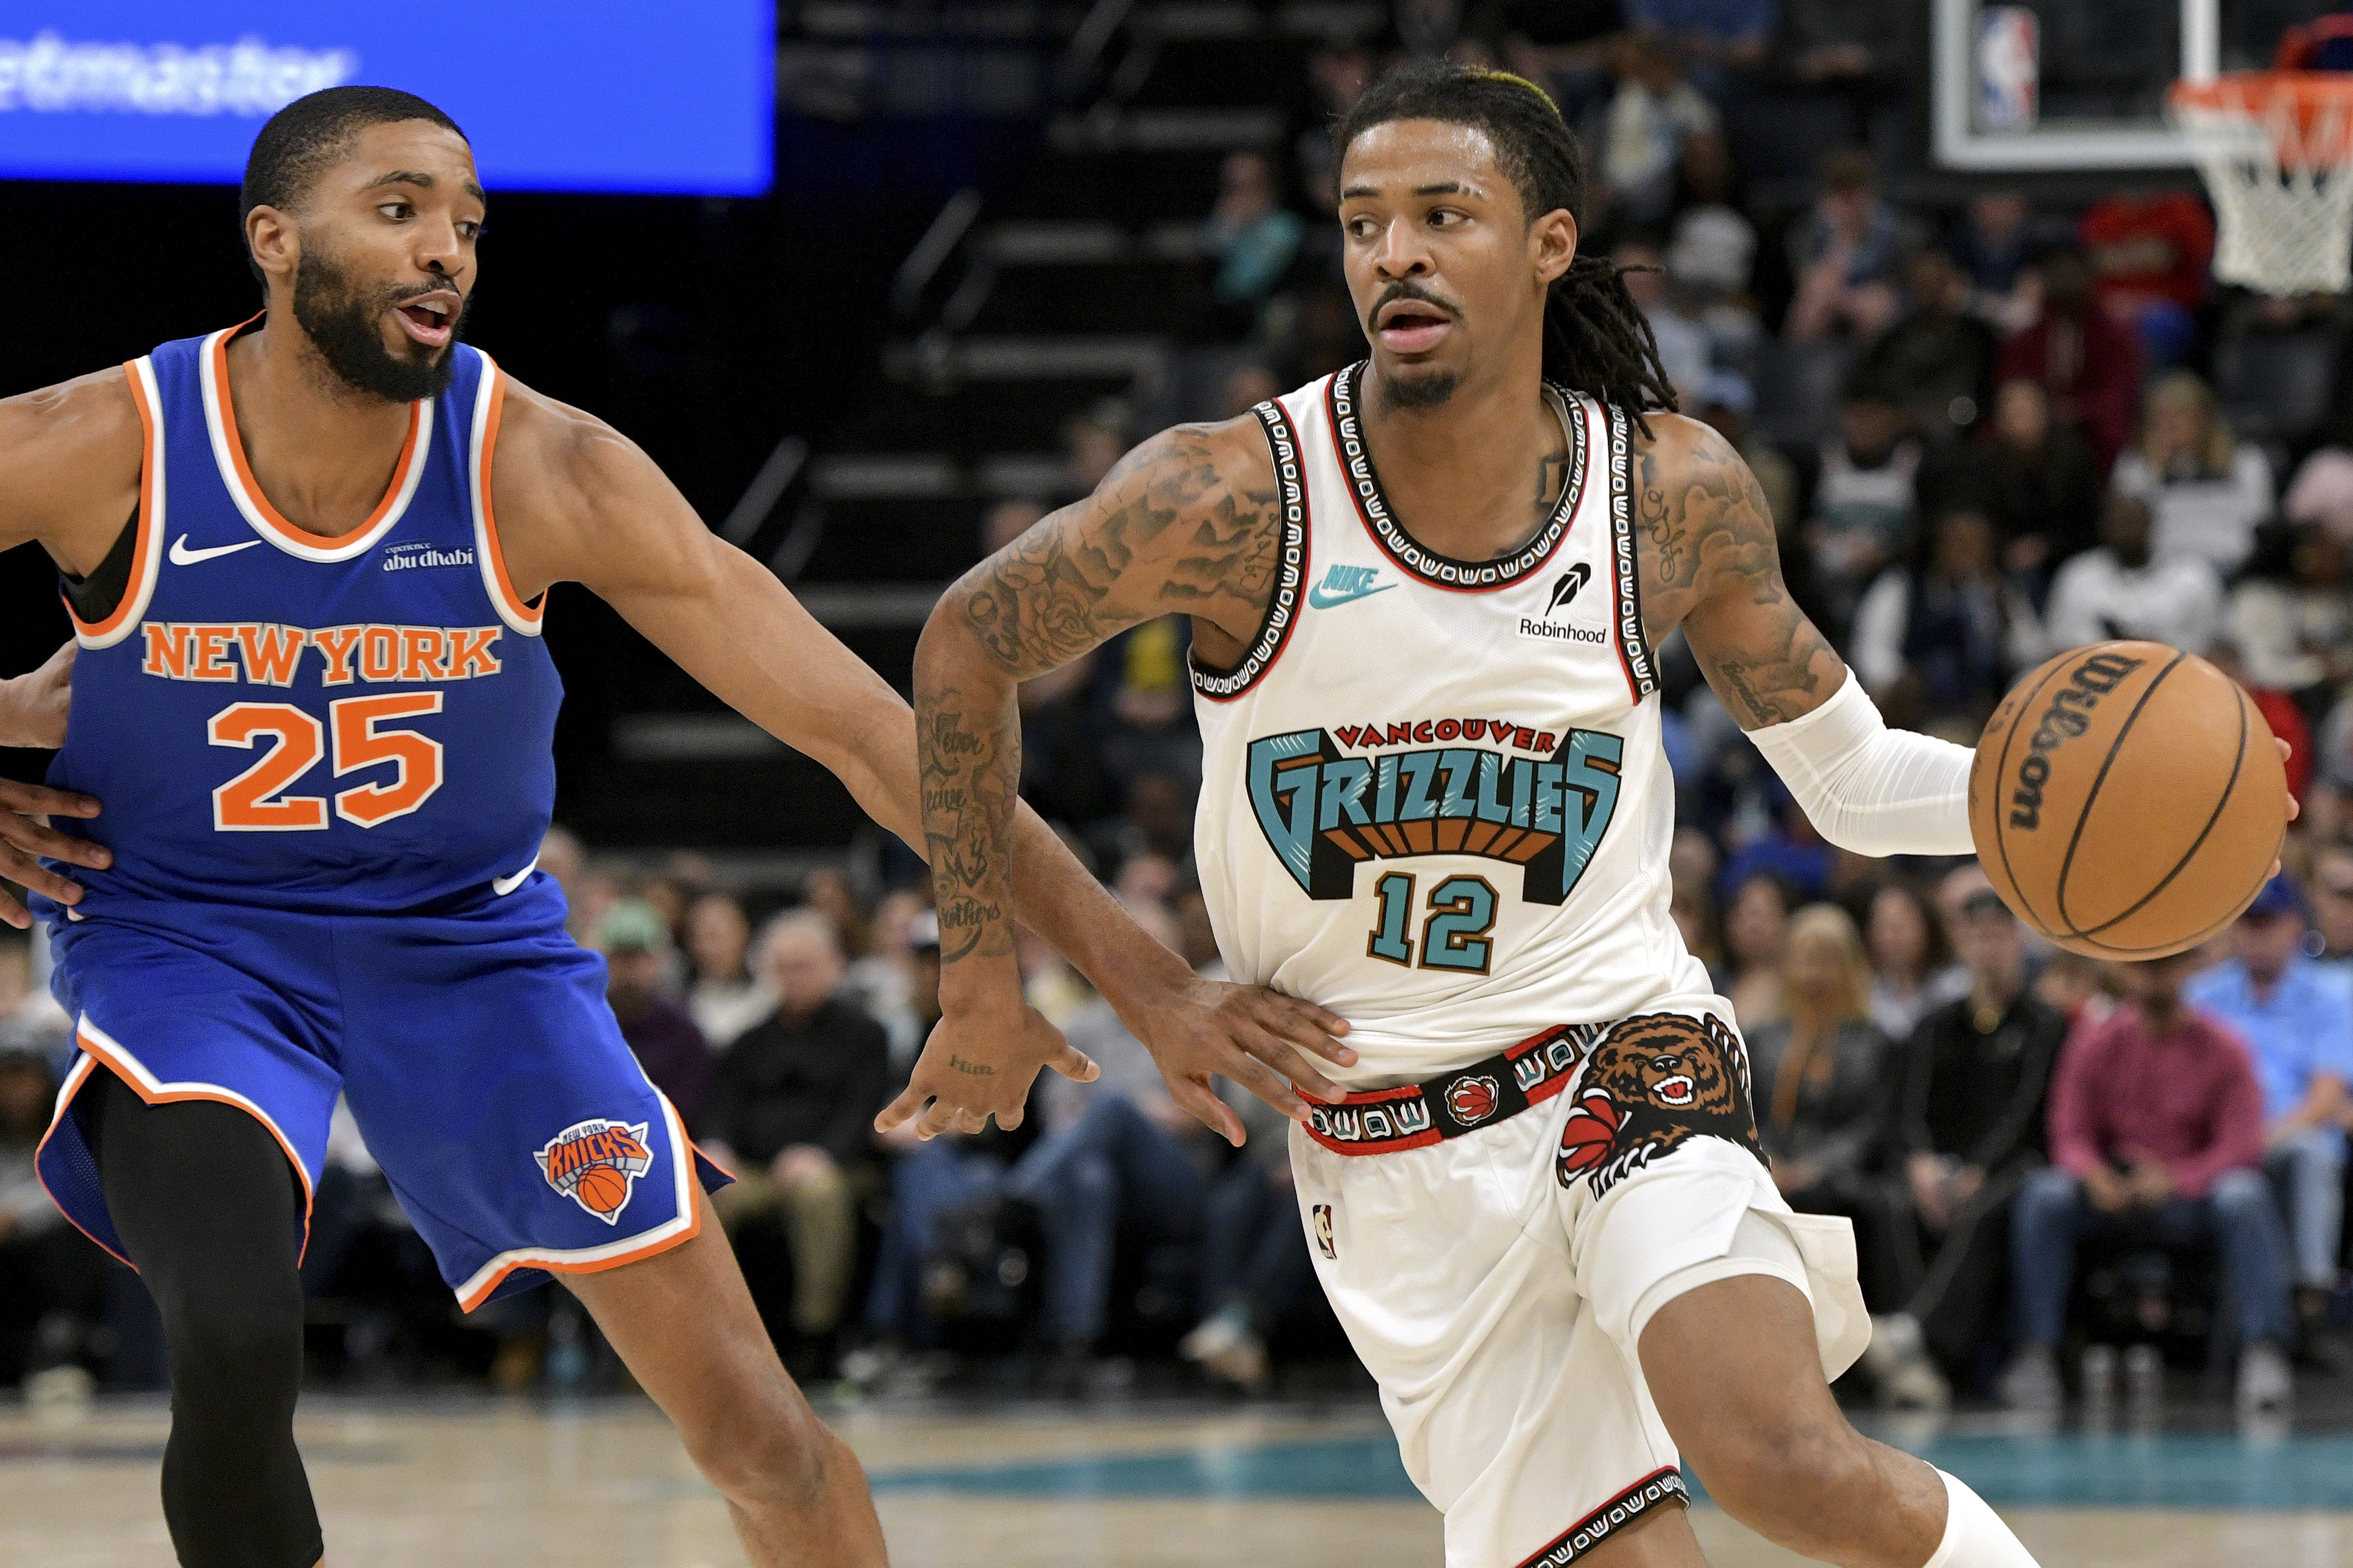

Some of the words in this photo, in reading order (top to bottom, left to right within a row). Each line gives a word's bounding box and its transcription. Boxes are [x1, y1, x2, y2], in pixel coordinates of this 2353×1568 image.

[383, 554, 417, 572] abu
[419, 548, 474, 567] dhabi
[1322, 564, 1379, 592] NIKE
[142, 622, 310, 688] NEW
[310, 624, 503, 688] YORK
[1520, 618, 1606, 644] Robinhood
[207, 690, 444, 832] 25
[1334, 718, 1557, 753] VANCOUVER
[2010, 653, 2146, 832] Wilson
[1245, 727, 1625, 906] GRIZZLIES
[1367, 870, 1500, 976] 12
[548, 1126, 649, 1184] KNICKS
[563, 1128, 581, 1144] NEW
[582, 1123, 606, 1137] YORK
